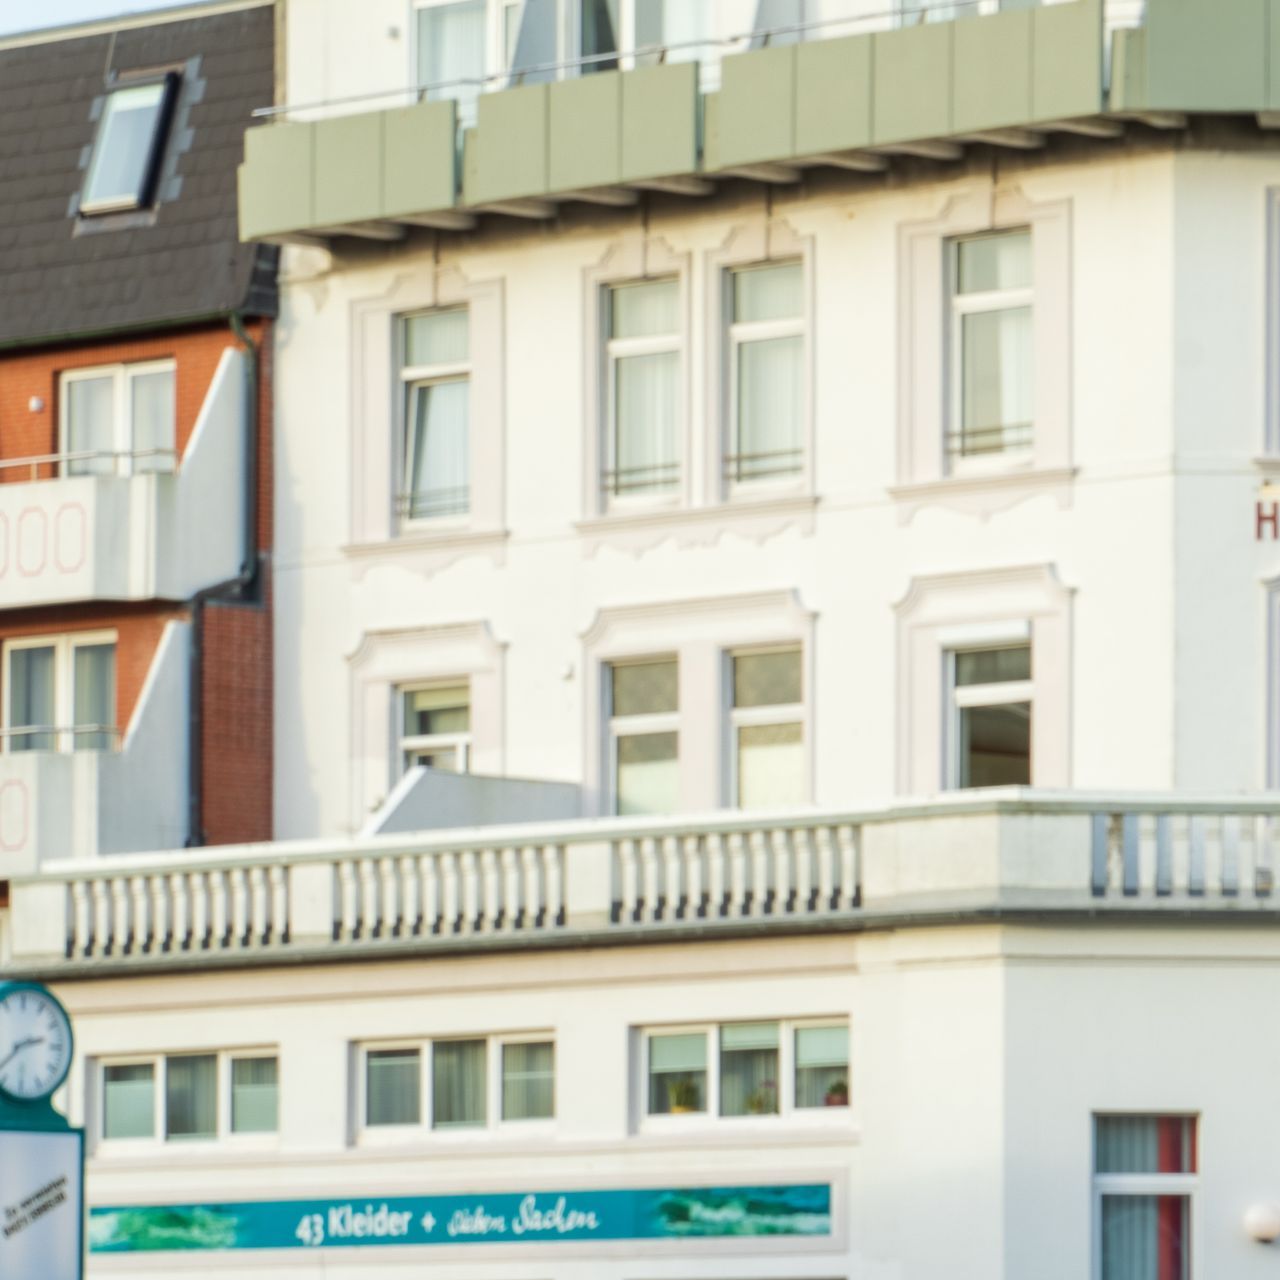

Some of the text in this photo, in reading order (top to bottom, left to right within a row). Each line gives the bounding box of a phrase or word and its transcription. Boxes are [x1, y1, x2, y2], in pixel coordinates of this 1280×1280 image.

[294, 1213, 325, 1246] 43
[328, 1203, 412, 1237] Kleider
[512, 1194, 600, 1235] Sachen
